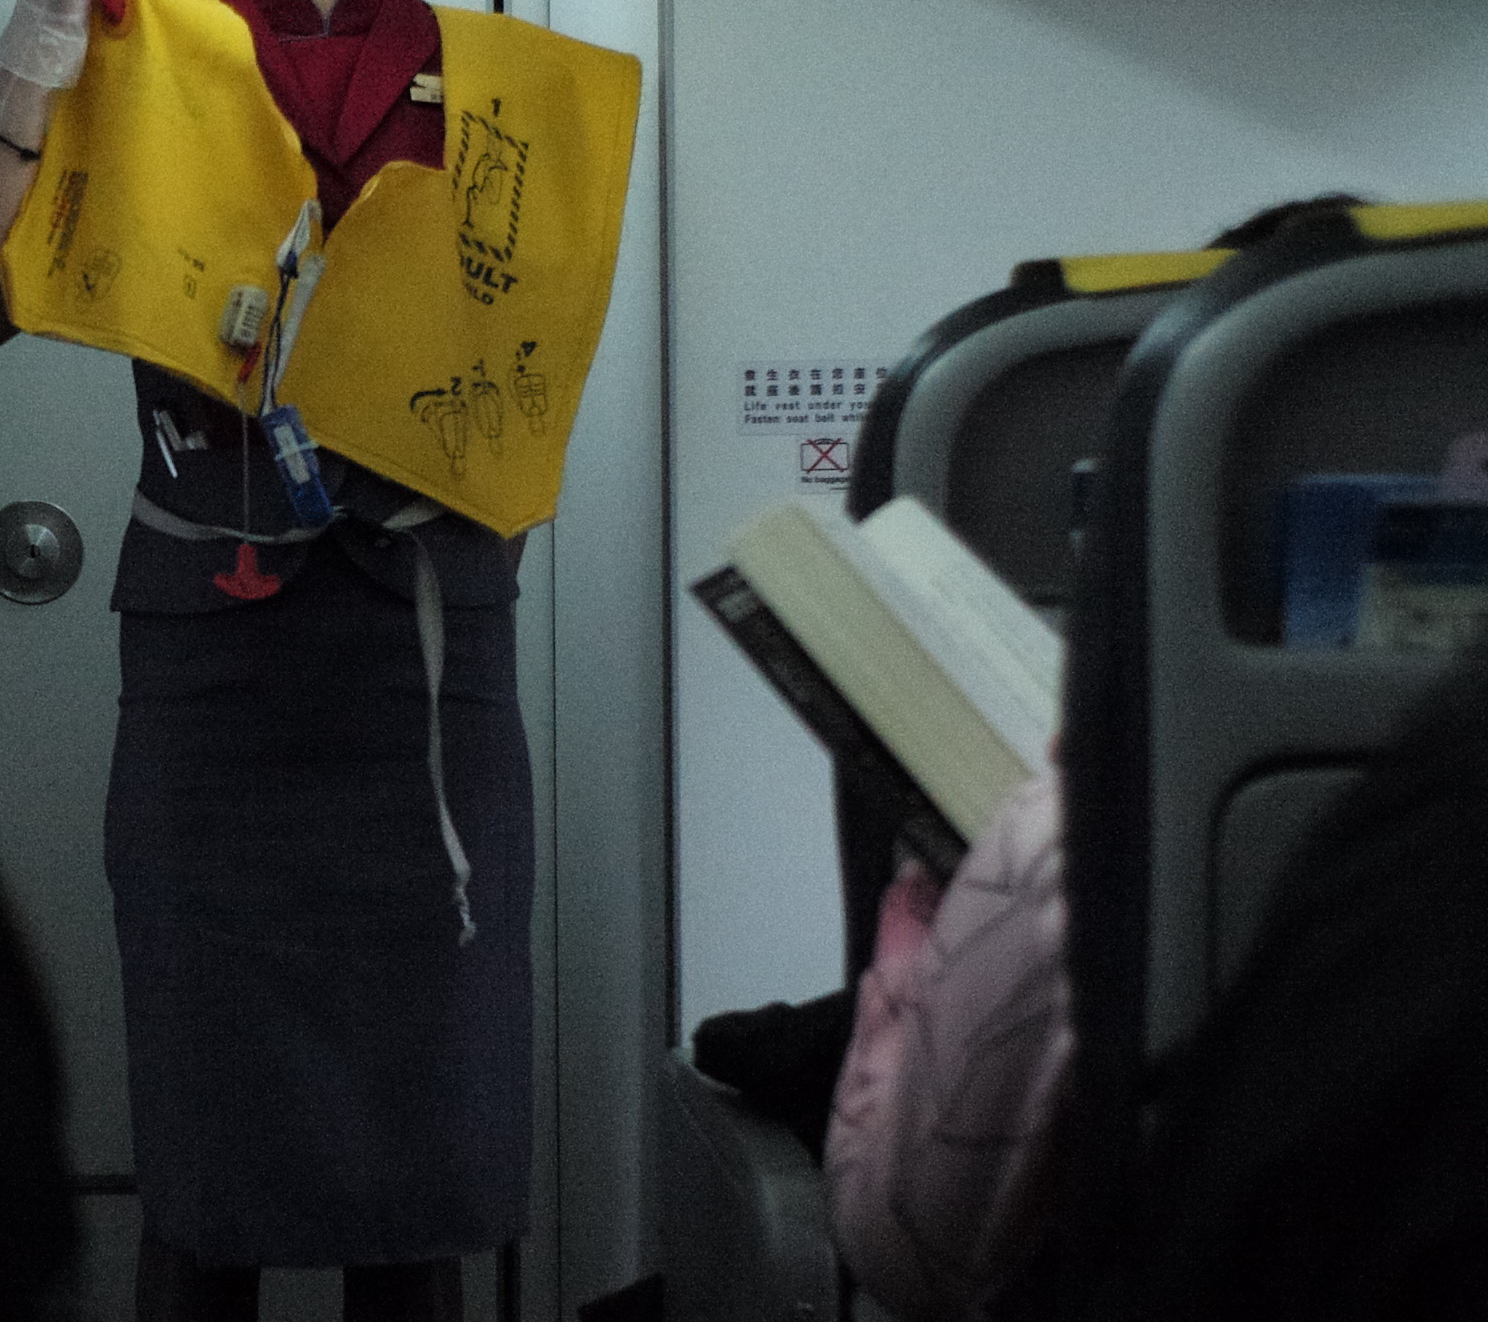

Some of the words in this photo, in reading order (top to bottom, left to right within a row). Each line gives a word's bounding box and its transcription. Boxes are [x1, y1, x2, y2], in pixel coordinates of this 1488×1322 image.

[460, 256, 518, 294] ULT
[744, 401, 767, 411] Life
[775, 401, 800, 411] vest
[807, 401, 842, 410] under
[744, 413, 779, 424] Fasten
